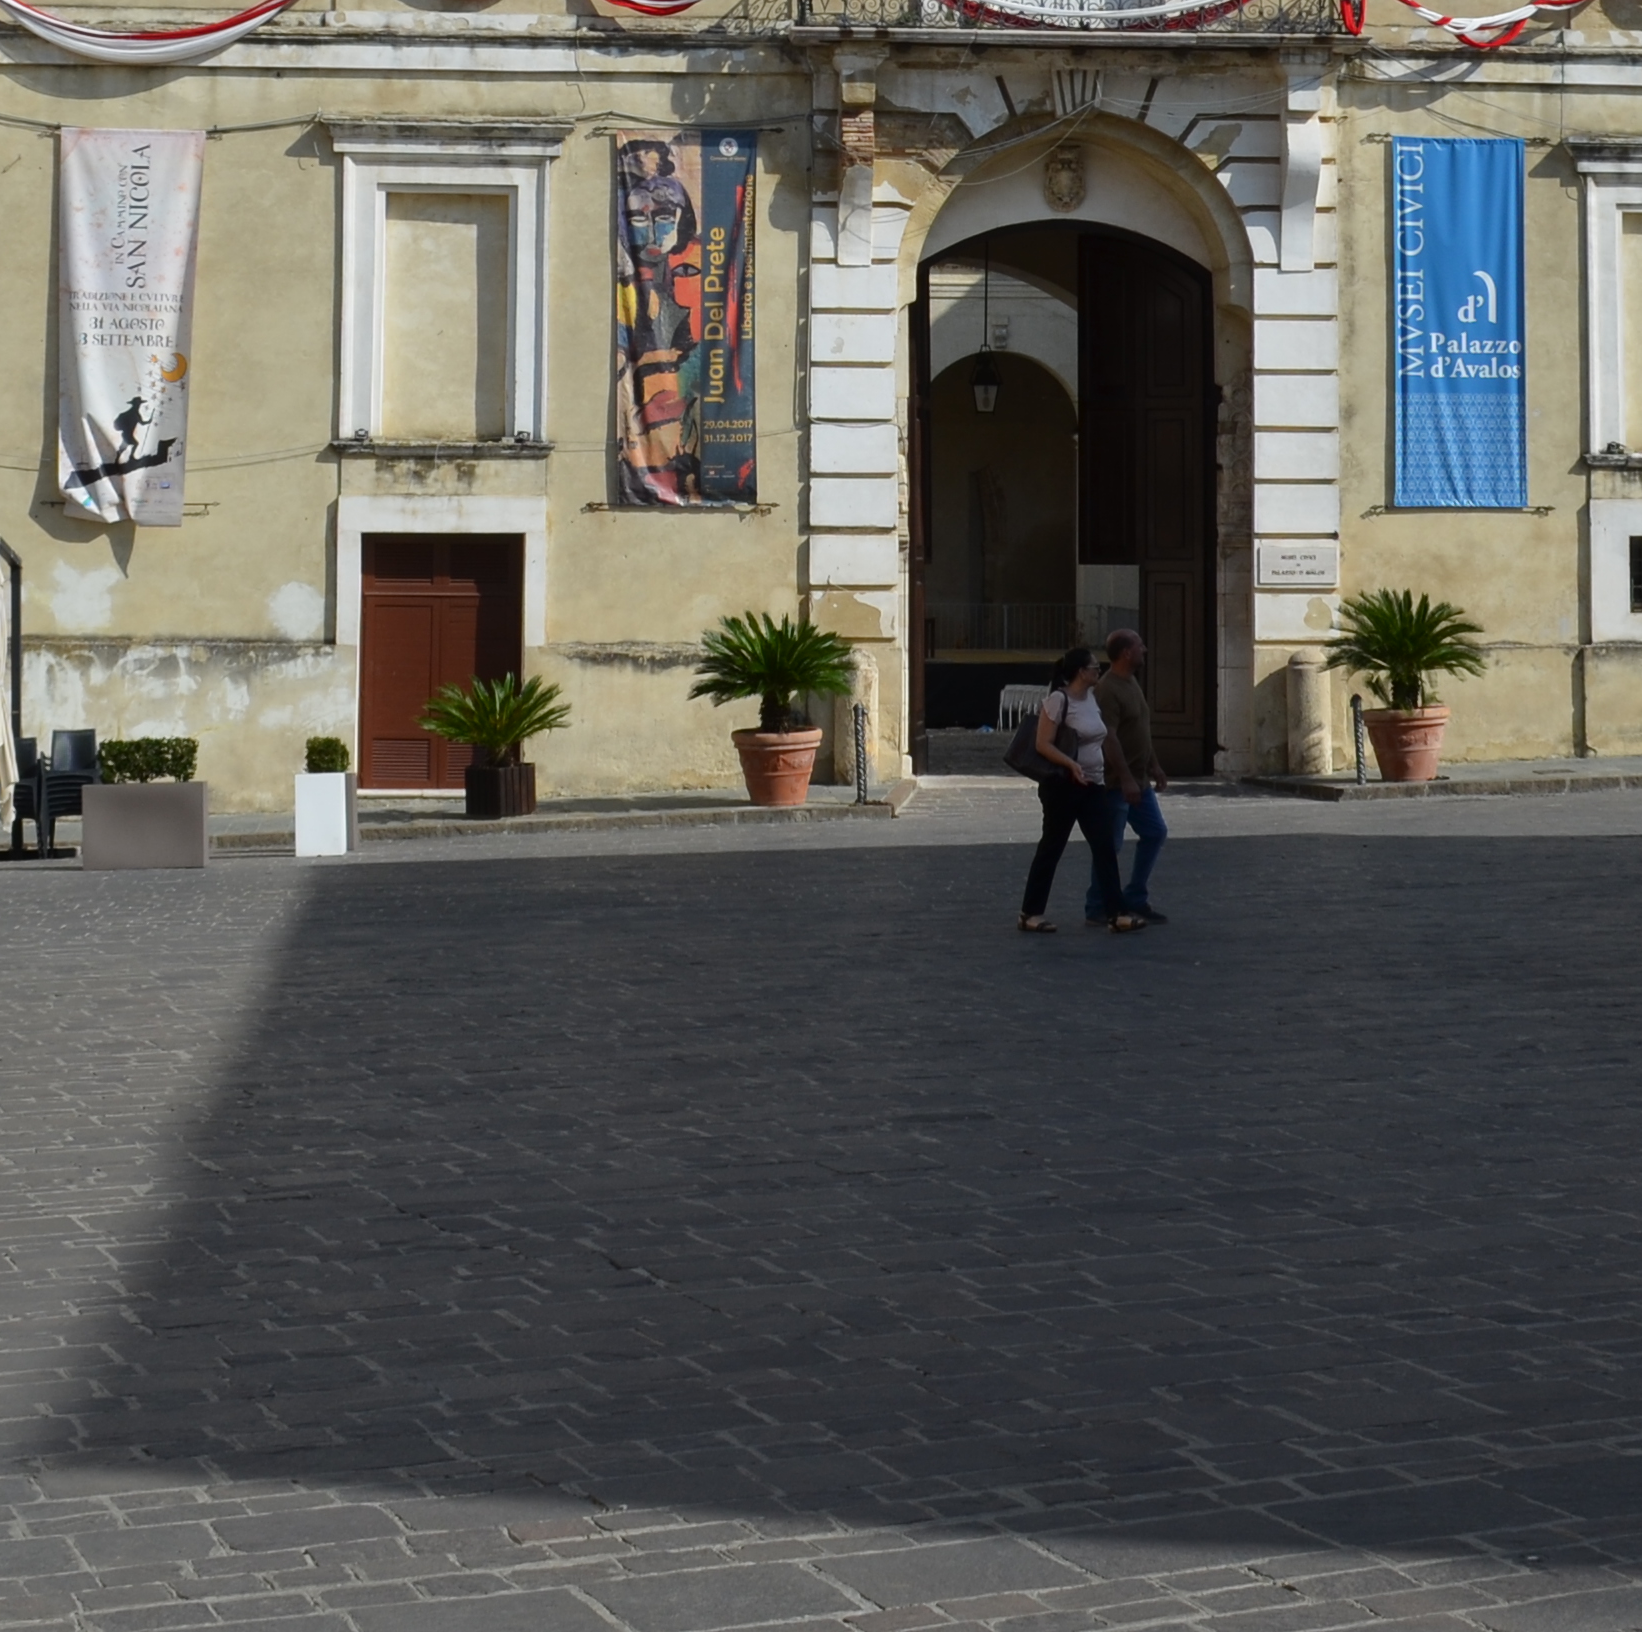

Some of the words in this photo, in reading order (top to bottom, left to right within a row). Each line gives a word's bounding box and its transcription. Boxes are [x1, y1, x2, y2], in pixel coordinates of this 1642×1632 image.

[129, 144, 151, 230] NICOLA
[1397, 143, 1424, 256] CIVICI
[742, 174, 754, 280] sperimentazione
[115, 253, 124, 264] IN
[126, 239, 147, 289] SAN
[705, 227, 725, 293] Prete
[745, 282, 753, 290] e
[89, 317, 104, 329] 31
[109, 317, 165, 330] AGOSTO
[704, 303, 724, 341] Del
[92, 333, 174, 347] SETTEMBRE
[1429, 332, 1521, 354] Palazzo
[704, 348, 725, 404] Juan
[1430, 356, 1521, 379] d'Avalos
[703, 419, 753, 429] 29.04.2017
